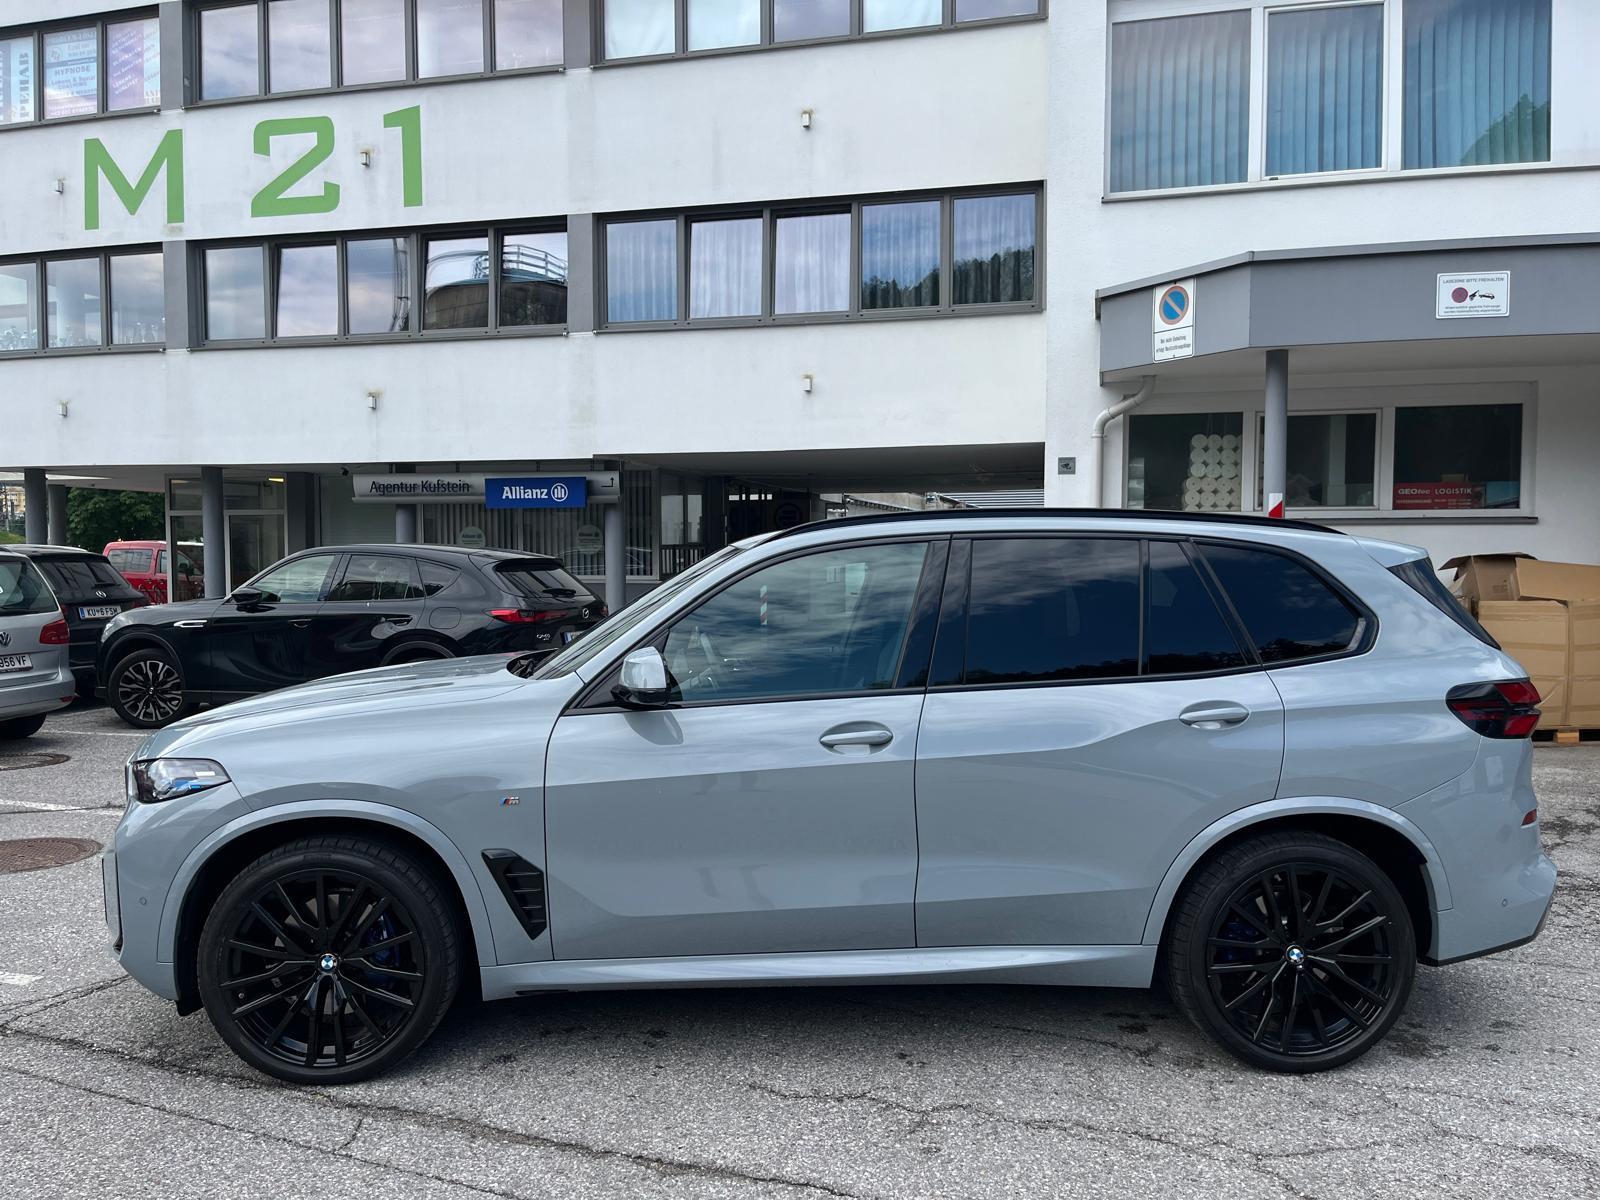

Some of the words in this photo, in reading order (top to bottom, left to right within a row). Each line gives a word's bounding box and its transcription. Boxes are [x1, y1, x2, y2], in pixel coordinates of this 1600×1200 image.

[54, 65, 90, 76] HYPNOSE
[86, 129, 183, 229] M
[369, 480, 417, 496] Agentur
[421, 479, 470, 492] Kufstein
[502, 486, 548, 499] Allianz
[1434, 487, 1472, 495] LOGISTIK
